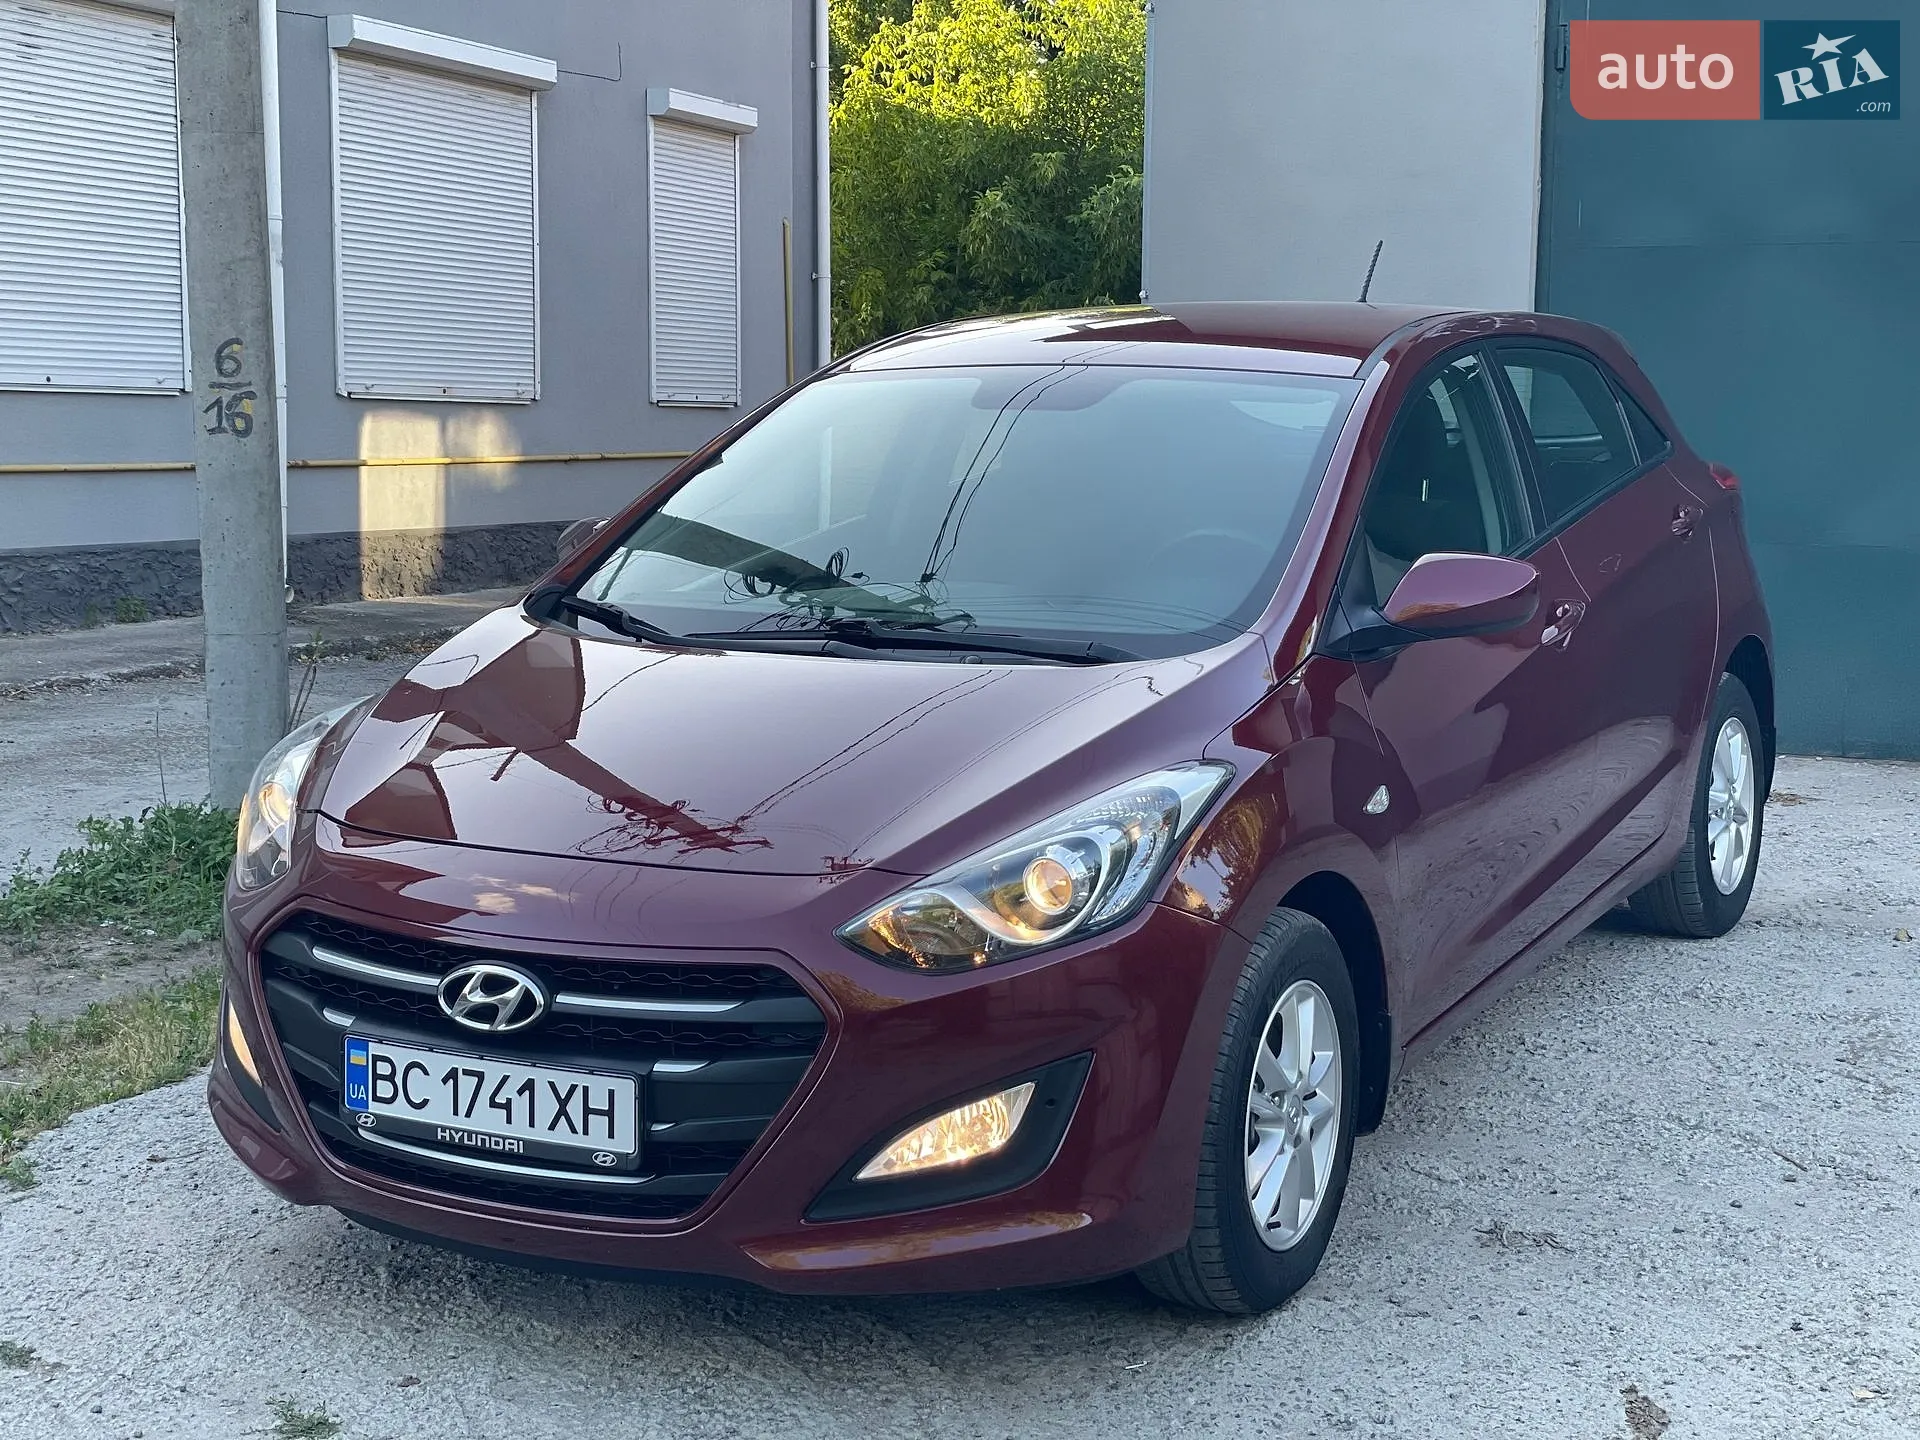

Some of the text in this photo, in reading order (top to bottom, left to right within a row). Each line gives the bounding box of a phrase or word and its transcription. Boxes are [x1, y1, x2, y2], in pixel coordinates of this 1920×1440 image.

[215, 338, 243, 378] 6
[203, 391, 257, 438] 16
[350, 1083, 366, 1101] UA
[437, 1127, 523, 1153] HYUNDAI
